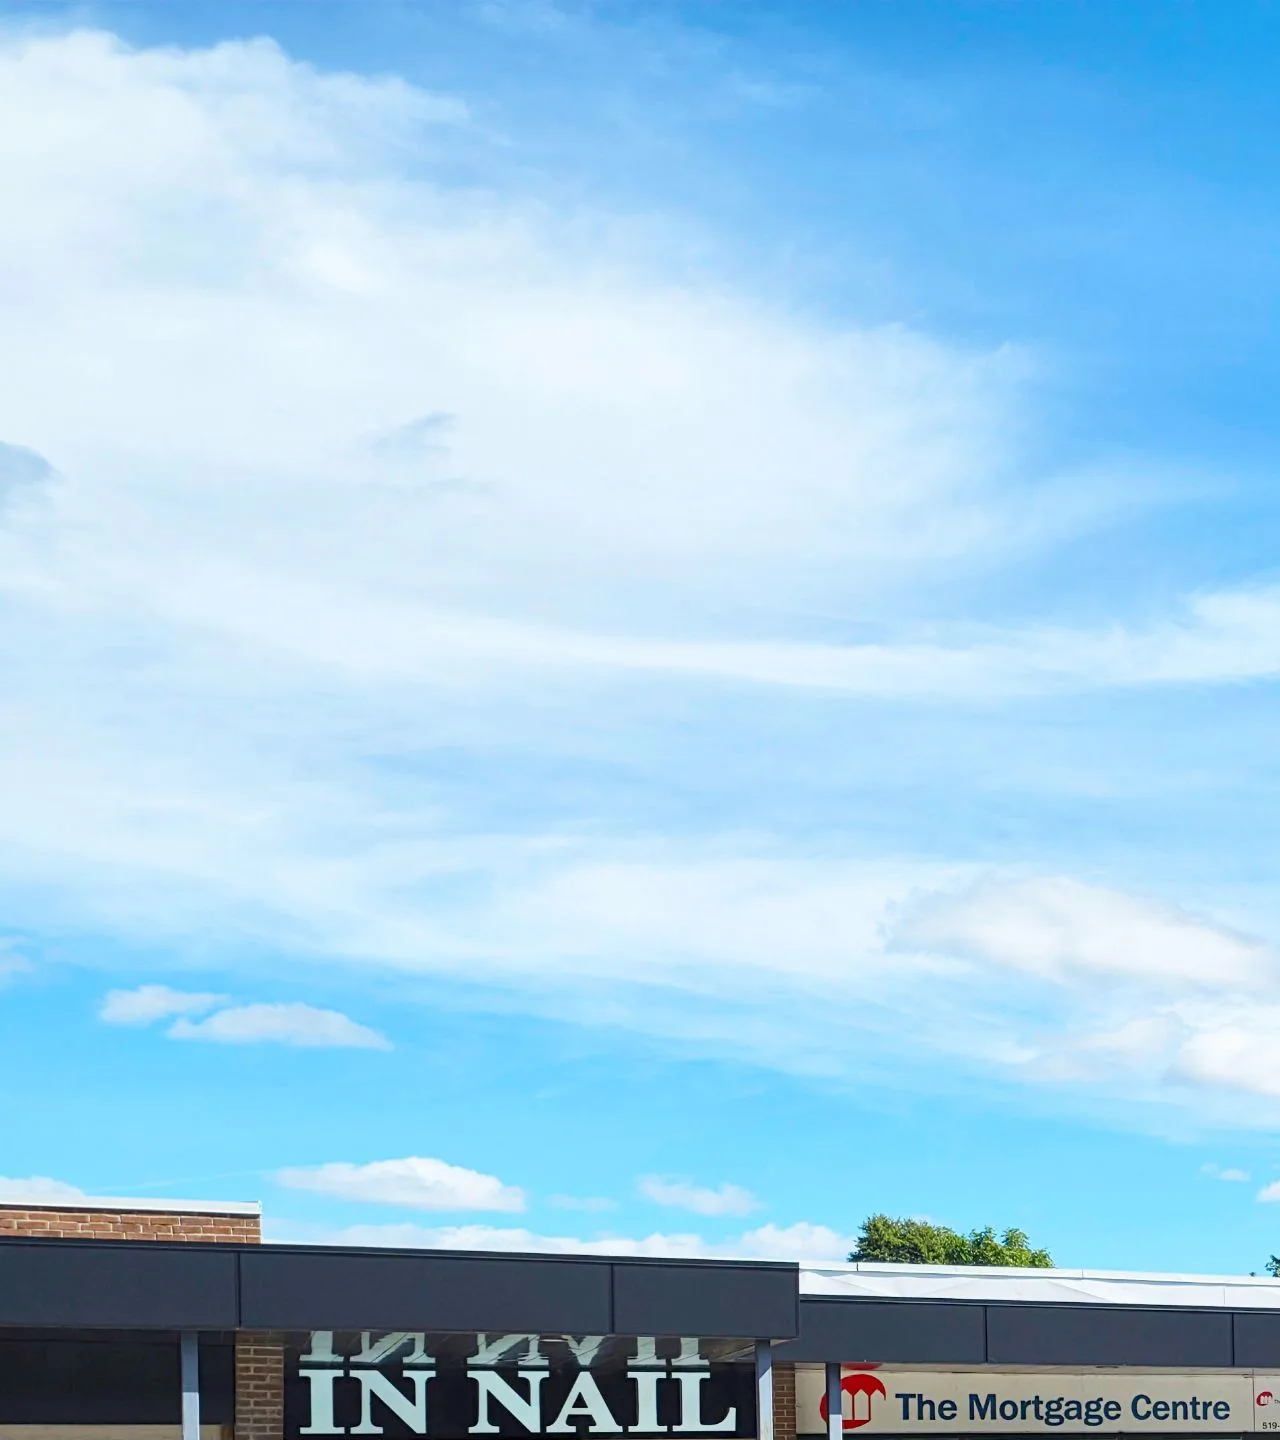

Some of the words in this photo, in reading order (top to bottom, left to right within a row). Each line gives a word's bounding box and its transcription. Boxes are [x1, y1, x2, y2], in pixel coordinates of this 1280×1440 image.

[298, 1369, 436, 1435] IN
[466, 1370, 737, 1434] NAIL
[894, 1393, 958, 1421] The
[968, 1392, 1122, 1428] Mortgage
[1130, 1393, 1231, 1421] Centre
